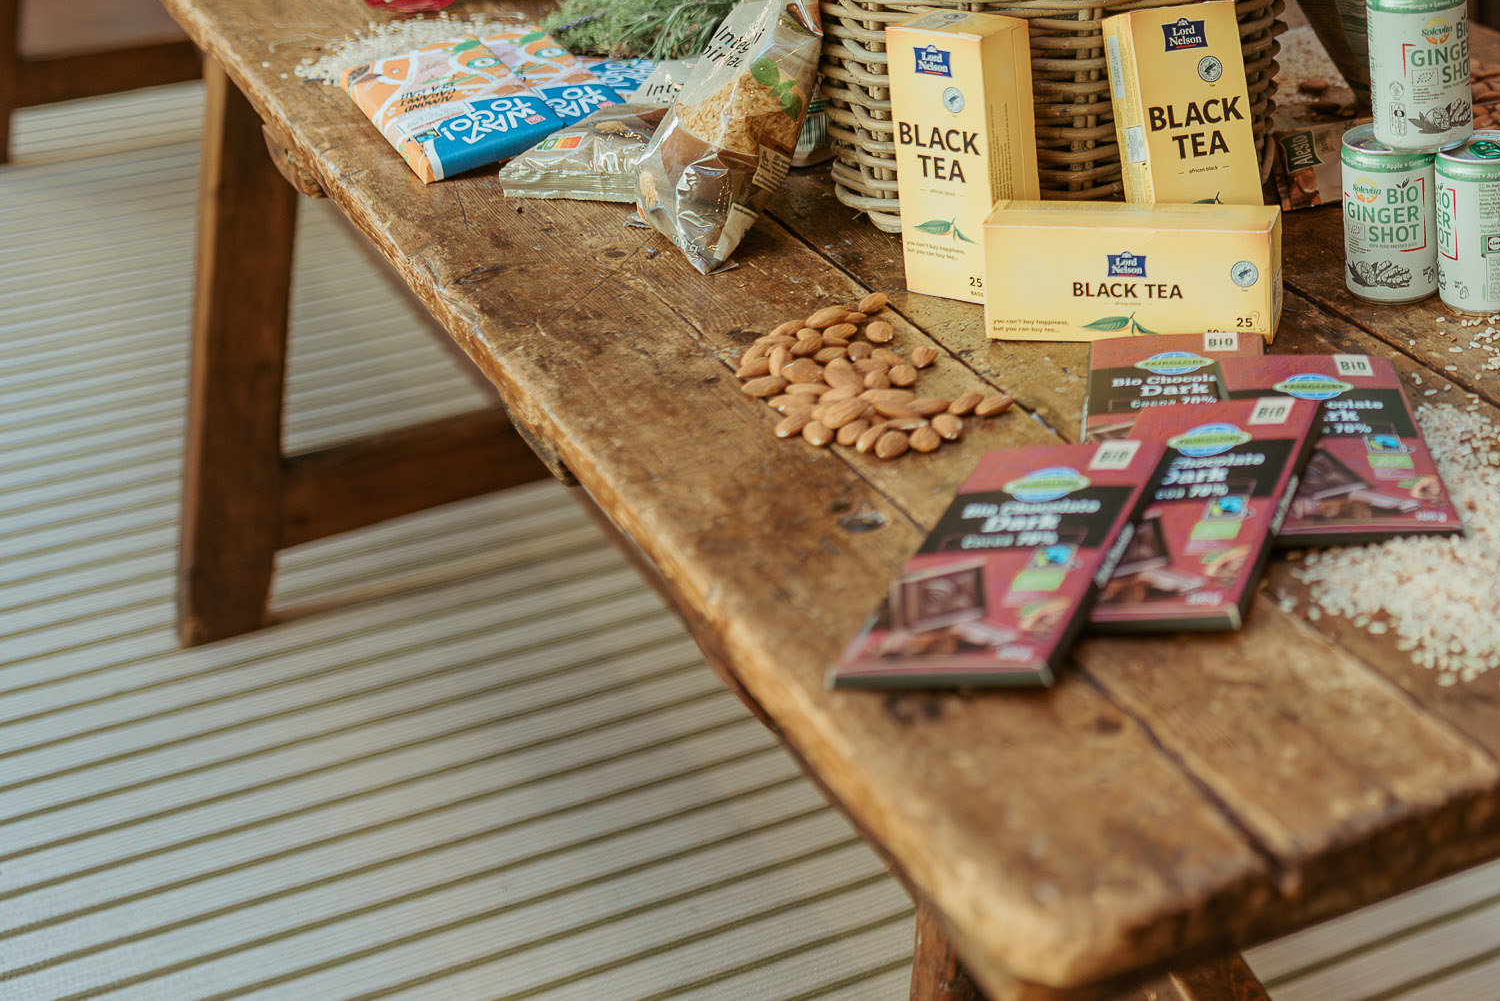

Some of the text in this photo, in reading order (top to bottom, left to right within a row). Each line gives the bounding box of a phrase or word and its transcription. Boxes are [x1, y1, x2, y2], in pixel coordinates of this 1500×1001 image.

[1172, 25, 1195, 37] Lord
[1169, 36, 1202, 47] Nelson
[921, 52, 943, 63] Lord
[1410, 41, 1469, 67] GINGE
[917, 60, 948, 73] Nelson
[491, 97, 532, 112] TO
[1149, 96, 1245, 132] BLACK
[462, 108, 537, 144] WAY
[899, 121, 980, 156] BLACK
[1171, 130, 1230, 160] TEA
[1292, 135, 1314, 166] Alesto
[917, 154, 966, 183] TEA
[1347, 201, 1420, 224] GINGER
[1368, 223, 1420, 243] SHOT
[1115, 257, 1138, 267] Lord
[1112, 265, 1143, 275] Nelson
[969, 276, 983, 288] 25
[1072, 281, 1183, 299] BLACK TEA
[1236, 317, 1253, 328] 25
[1112, 377, 1143, 388] Bio
[1140, 382, 1210, 397] Dark
